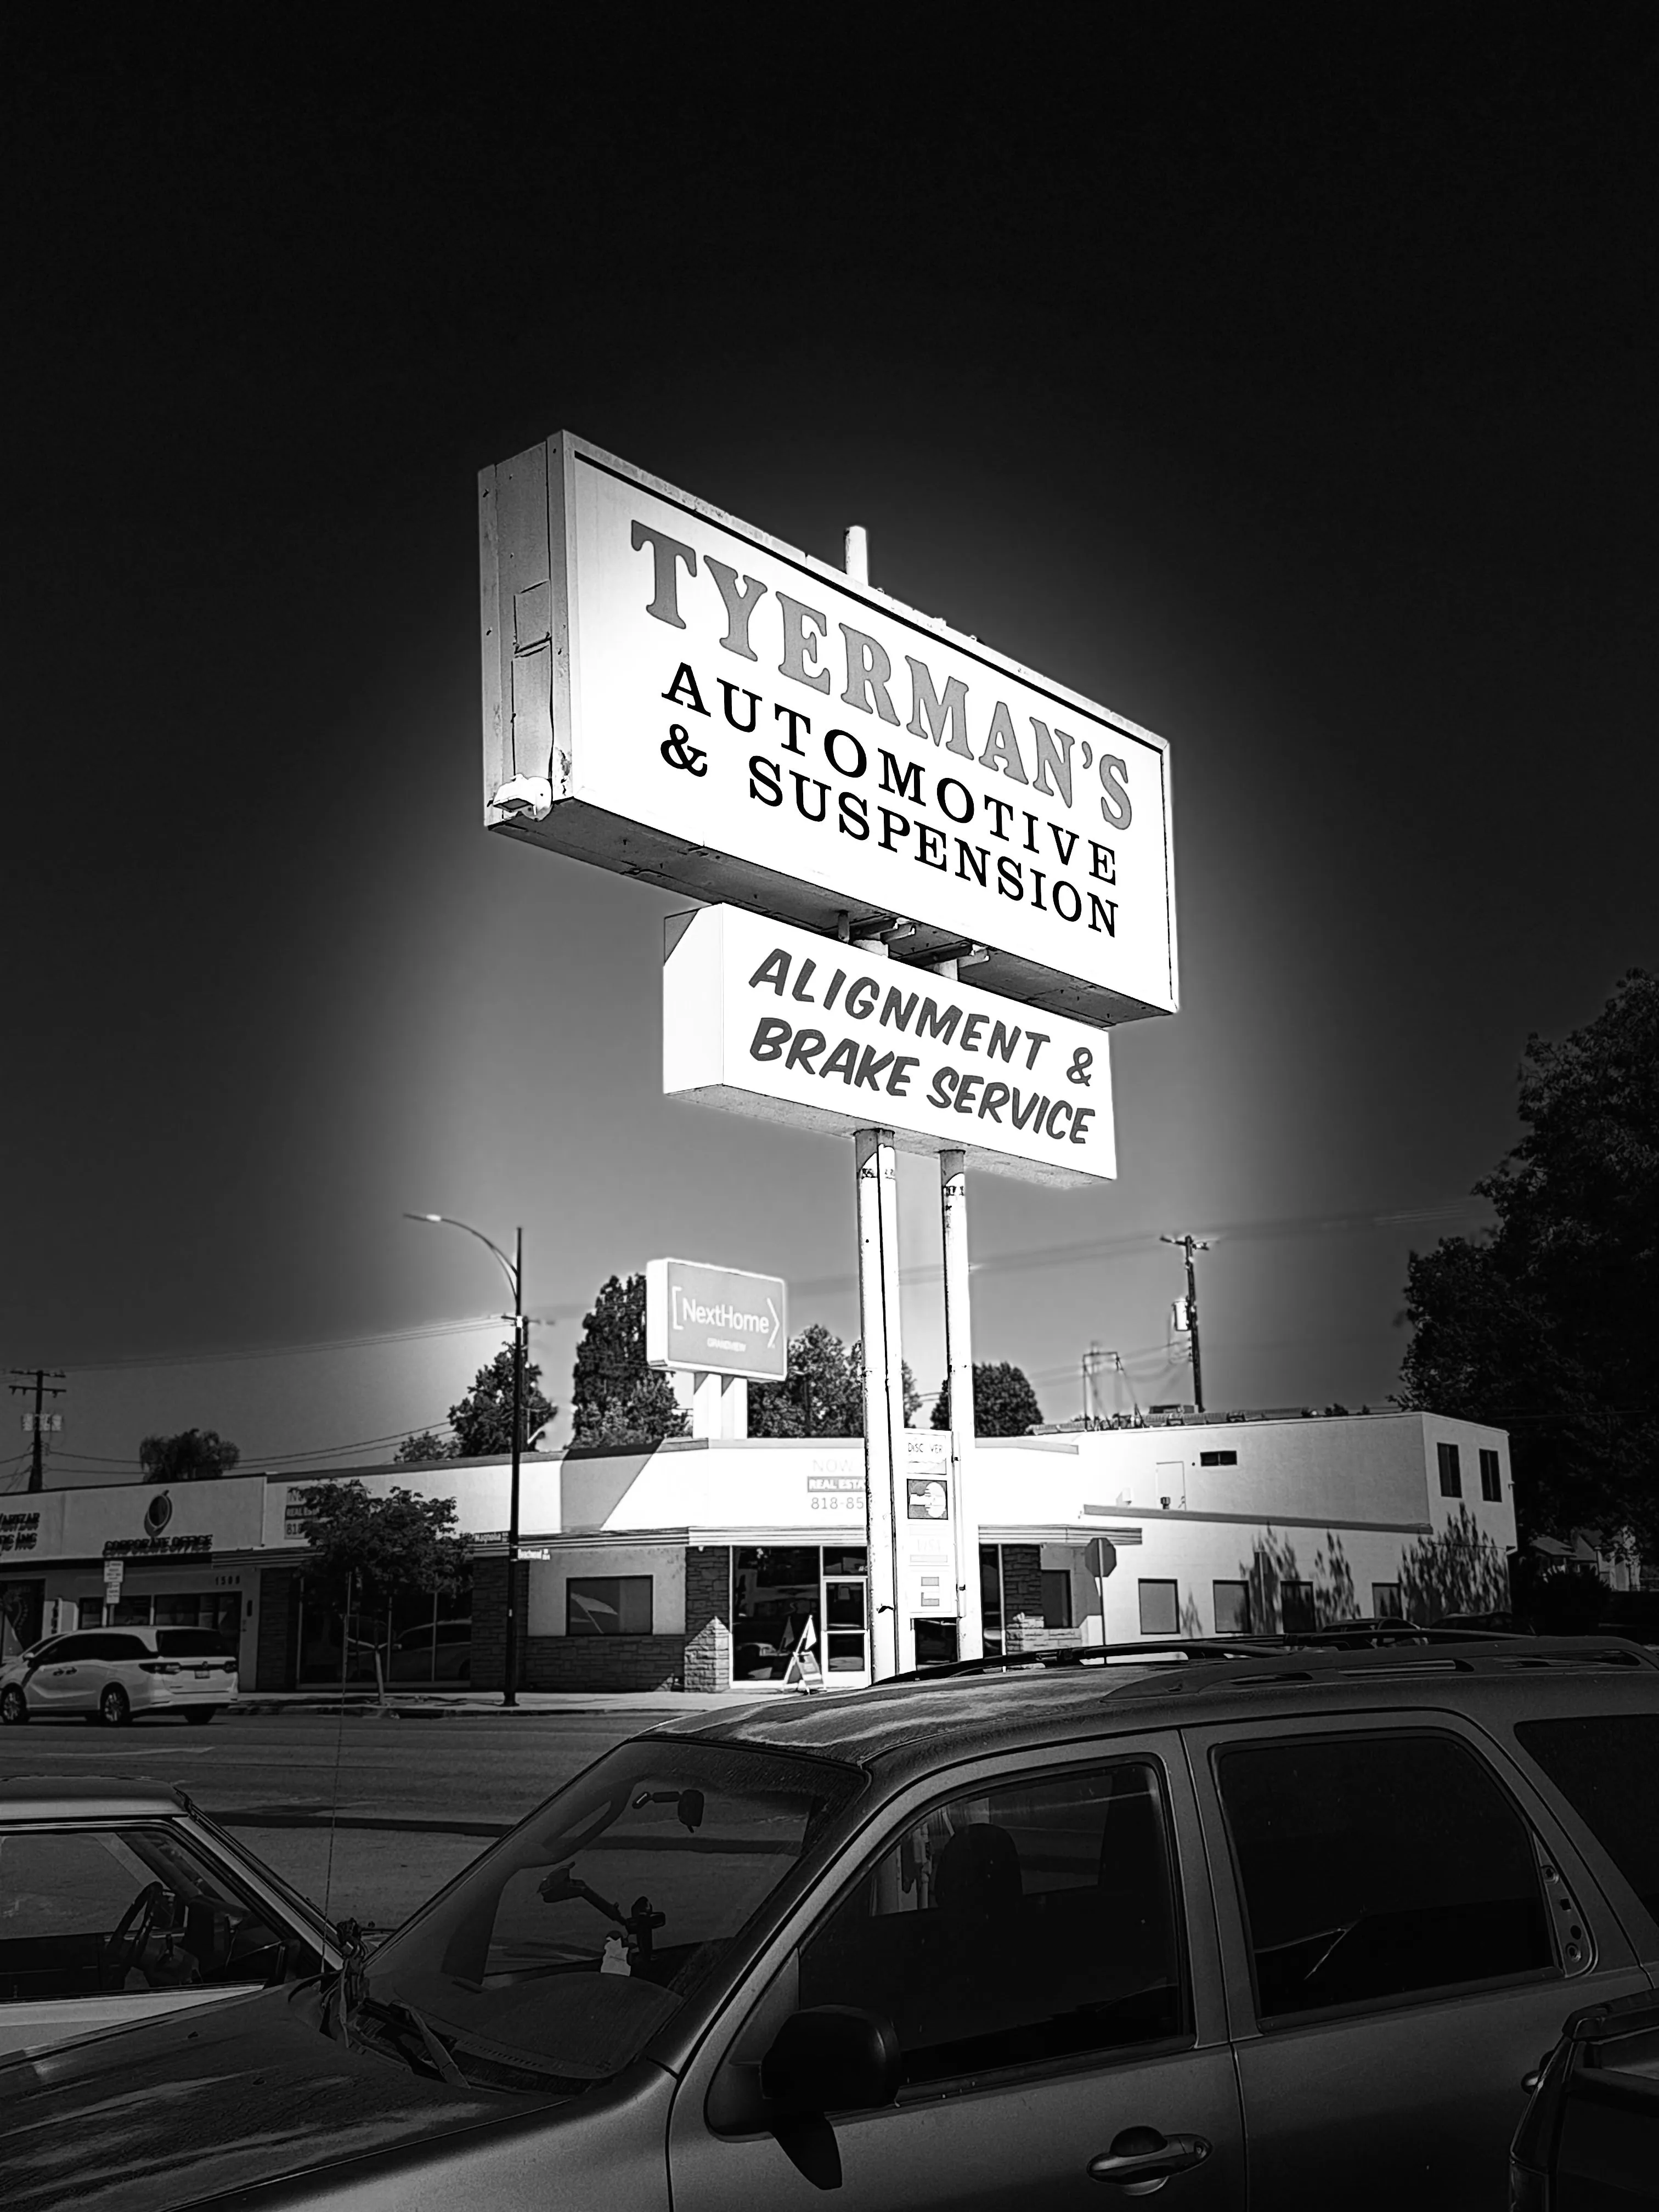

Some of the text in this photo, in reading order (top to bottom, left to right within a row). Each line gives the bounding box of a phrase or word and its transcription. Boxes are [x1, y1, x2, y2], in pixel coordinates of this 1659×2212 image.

[631, 520, 1132, 830] TYERMAN'S
[661, 662, 1116, 885] AUTOMOTIVE
[661, 724, 1119, 938] & SUSPENSION
[748, 947, 1093, 1087] ALIGNMENT &
[749, 1017, 1096, 1144] BRAKE SERVICE
[682, 1297, 769, 1334] NextHome
[809, 1479, 837, 1489] REAL
[810, 1496, 864, 1510] 818-85
[908, 1442, 943, 1454] DISCVER
